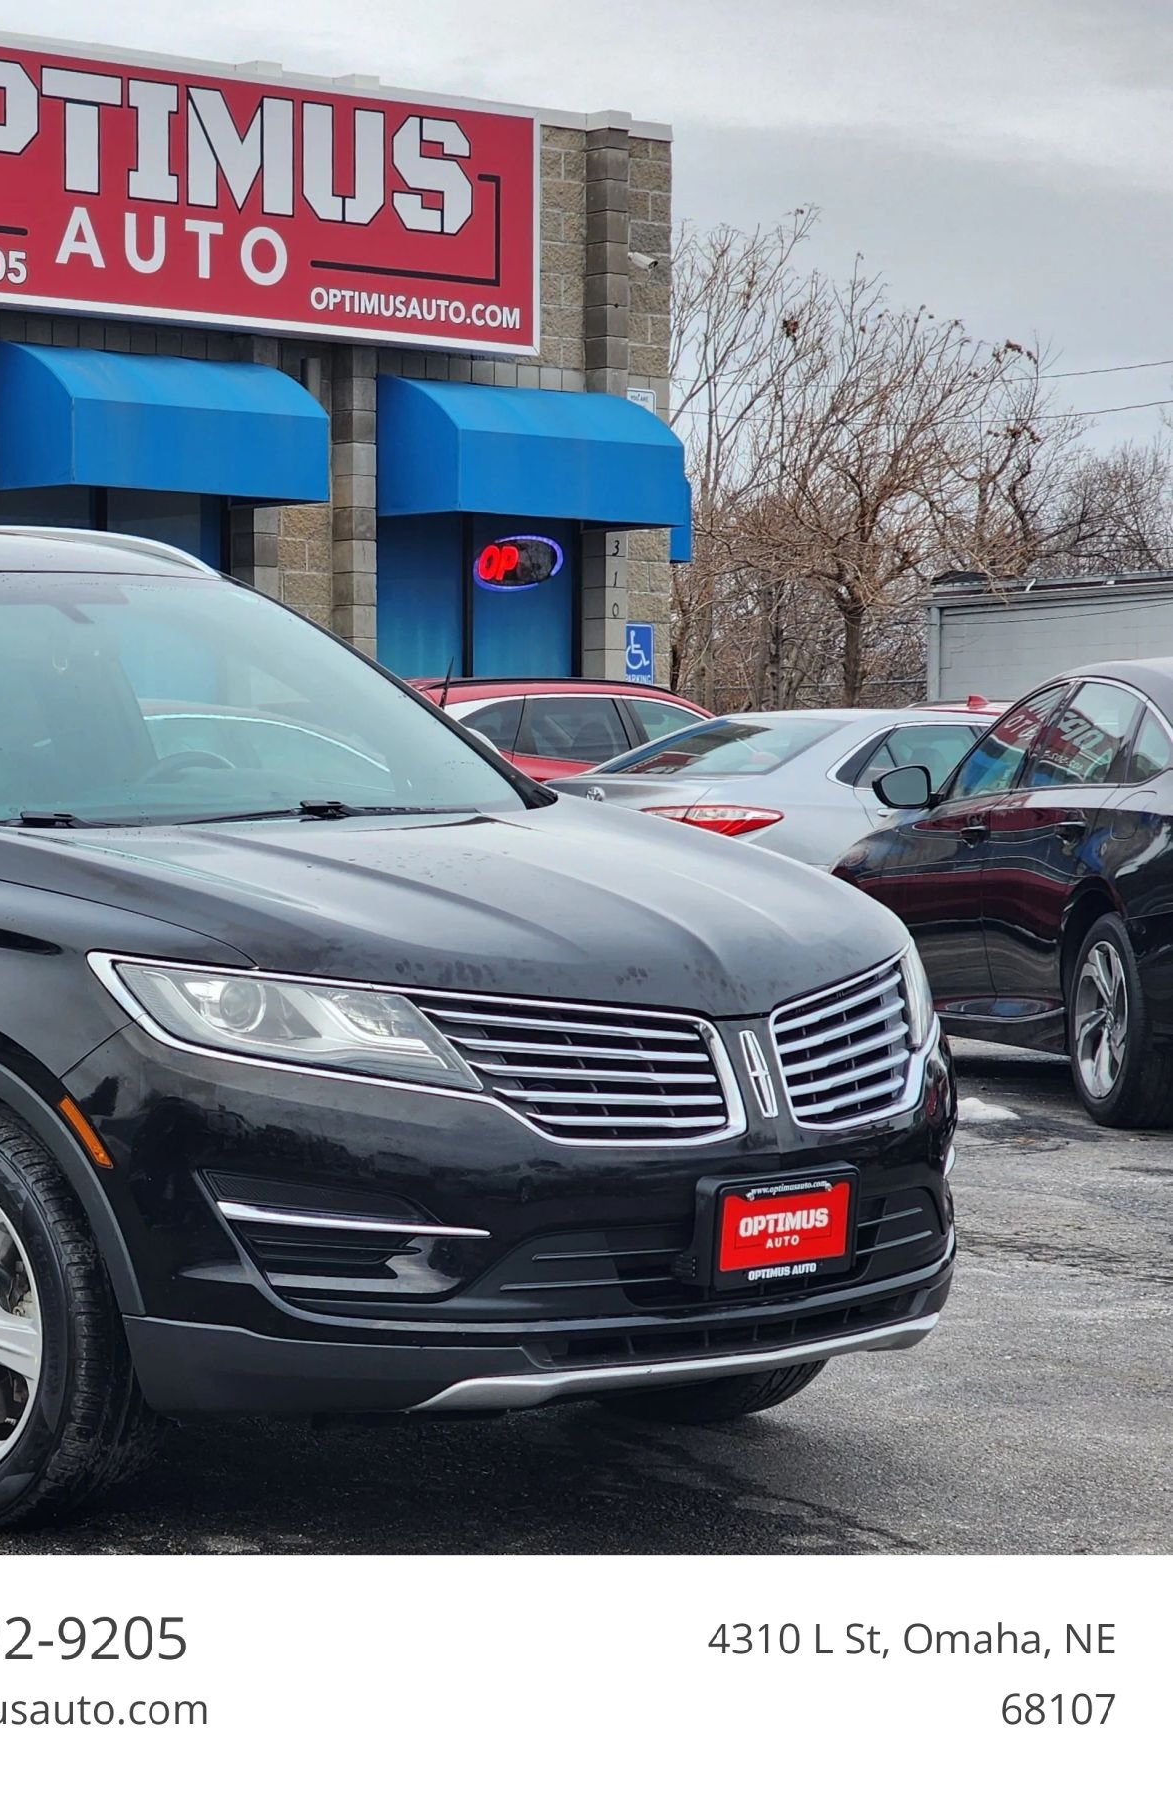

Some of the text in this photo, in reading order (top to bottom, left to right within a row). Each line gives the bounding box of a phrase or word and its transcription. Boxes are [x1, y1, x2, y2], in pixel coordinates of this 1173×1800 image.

[55, 206, 288, 286] AUTO
[310, 287, 521, 330] OPTIMUSAUTO.COM
[750, 1180, 827, 1196] www.optimusauto.com
[739, 1207, 829, 1238] OPTIMUS
[765, 1234, 800, 1249] AUTO
[748, 1262, 817, 1281] OPTIMUS AUTO
